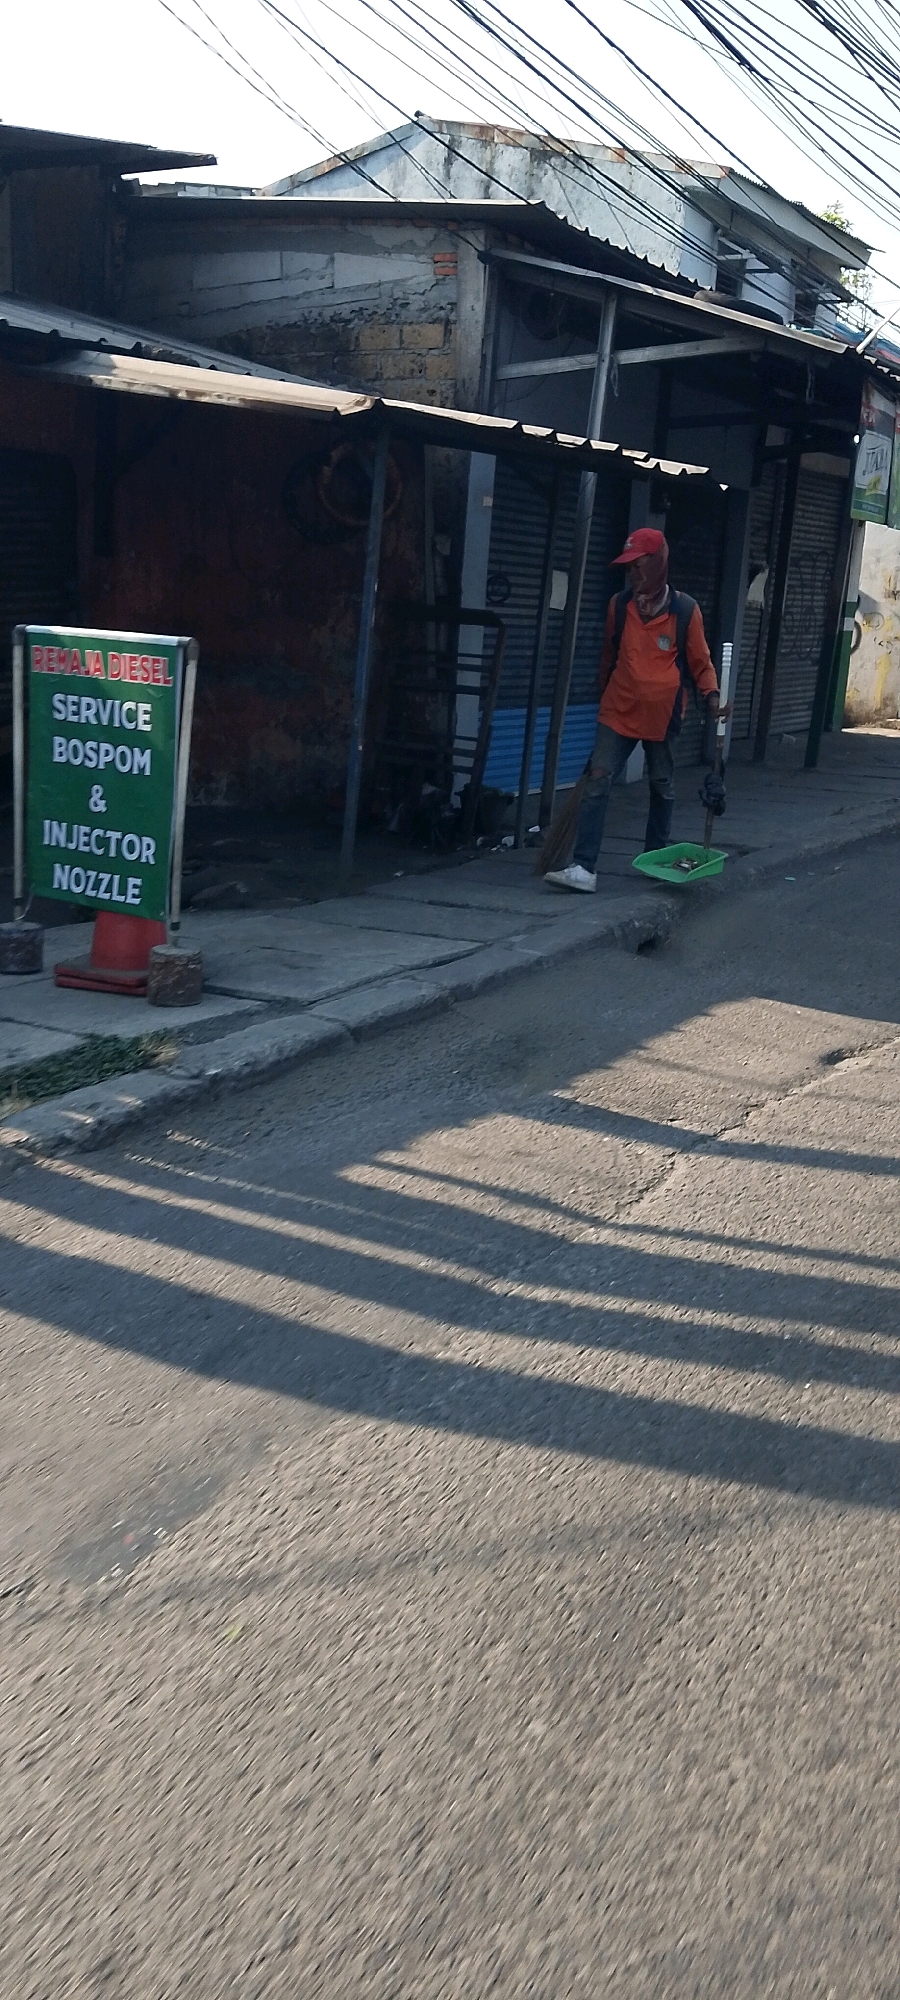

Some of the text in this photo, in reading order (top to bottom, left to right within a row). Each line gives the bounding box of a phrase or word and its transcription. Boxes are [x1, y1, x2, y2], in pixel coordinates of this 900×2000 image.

[31, 645, 174, 687] REMAJA DIESEL
[52, 693, 153, 732] SERVICE
[52, 736, 152, 776] BOSPOM
[89, 784, 108, 813] &
[43, 819, 157, 865] INJECTOR
[52, 863, 143, 905] NOZZLE
